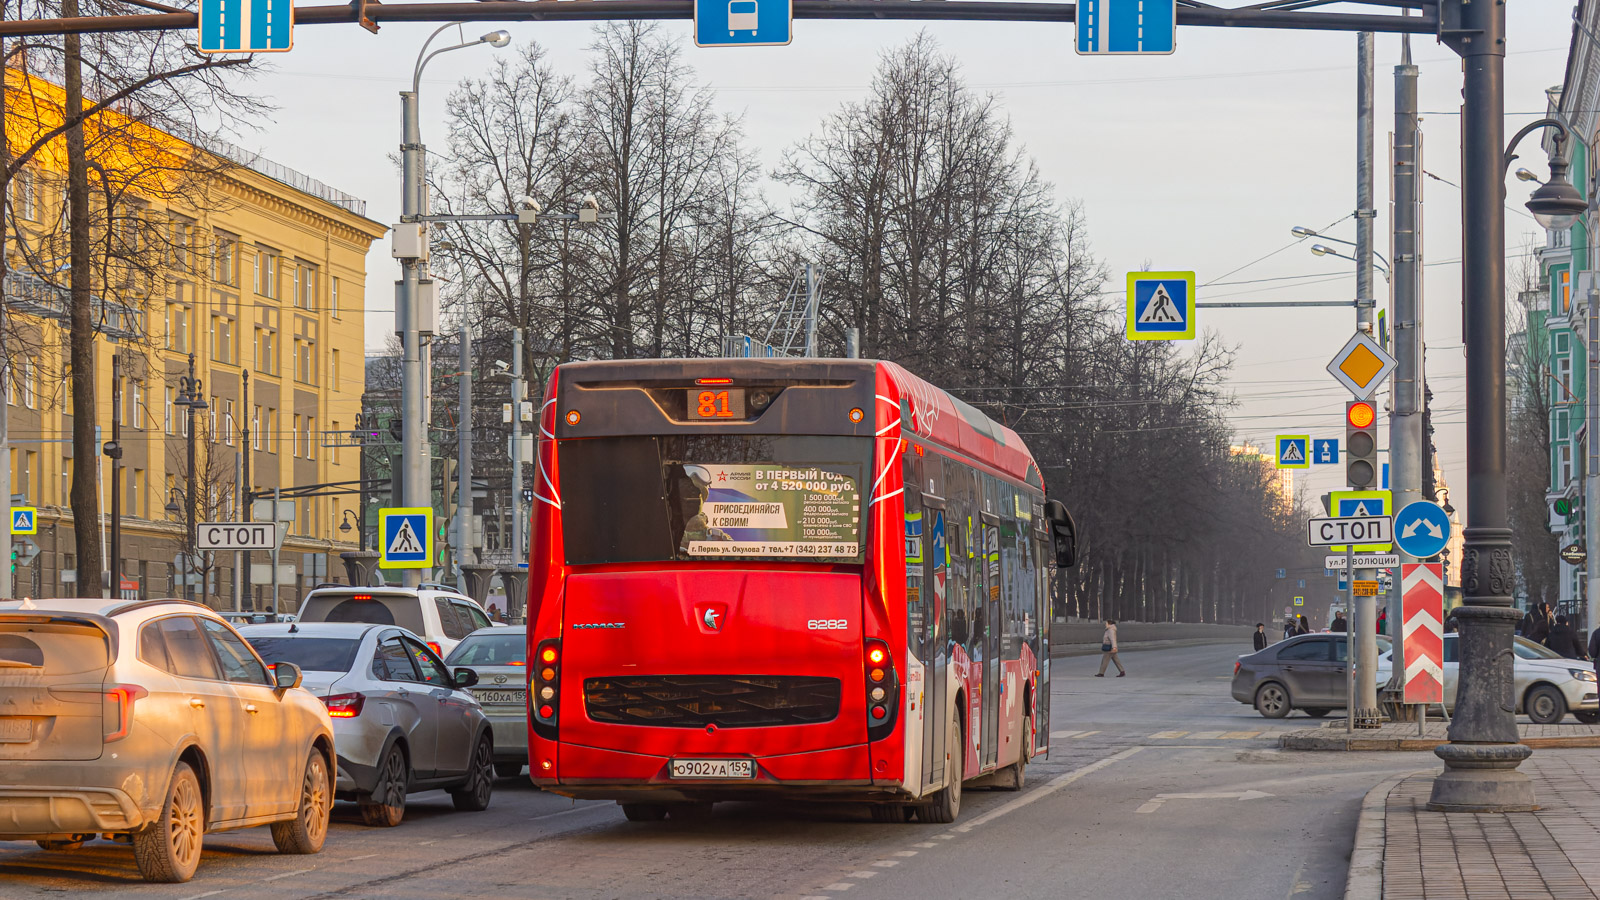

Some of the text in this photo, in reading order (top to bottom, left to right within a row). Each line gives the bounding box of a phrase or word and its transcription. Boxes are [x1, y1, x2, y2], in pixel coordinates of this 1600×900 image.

[697, 391, 734, 417] 81
[755, 470, 764, 480] В
[767, 468, 817, 480] ПЕРВЫЙ
[755, 481, 855, 493] от 4 520 000 руб.
[713, 503, 780, 515] ПРИСОЕДИНЯЙСЯ
[712, 517, 749, 527] К СВОИМ!
[208, 527, 265, 545] СТОП
[1320, 521, 1381, 541] СТОП
[732, 546, 760, 554] Окулова
[795, 545, 816, 554] (342)
[1328, 557, 1396, 567] ул.РВОЛЮЦИИ
[807, 619, 848, 630] 6282
[677, 761, 748, 775] О902УА 159
